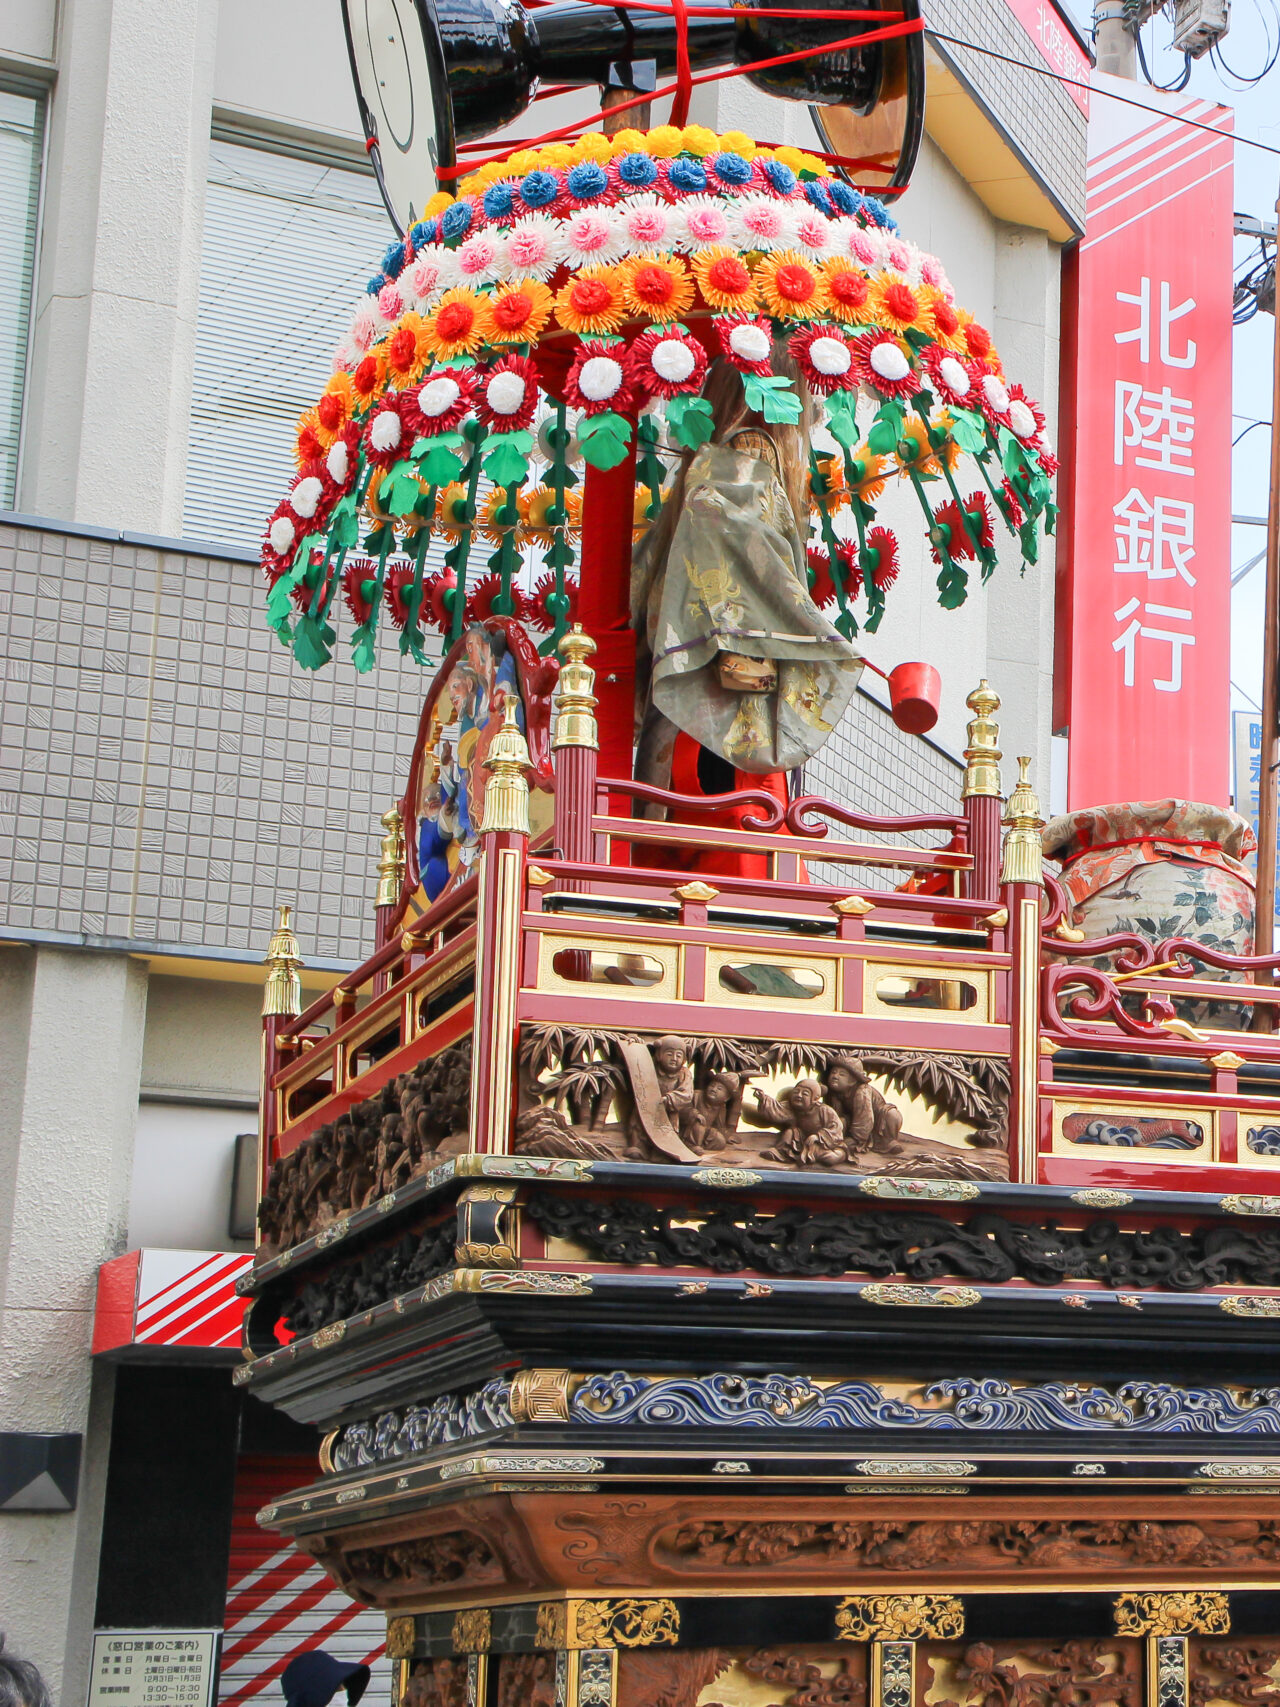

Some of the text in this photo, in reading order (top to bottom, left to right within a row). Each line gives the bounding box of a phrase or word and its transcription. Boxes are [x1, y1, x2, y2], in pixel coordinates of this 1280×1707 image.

[1036, 2, 1089, 106] 北陸銀行
[1112, 276, 1197, 692] 北陸銀行
